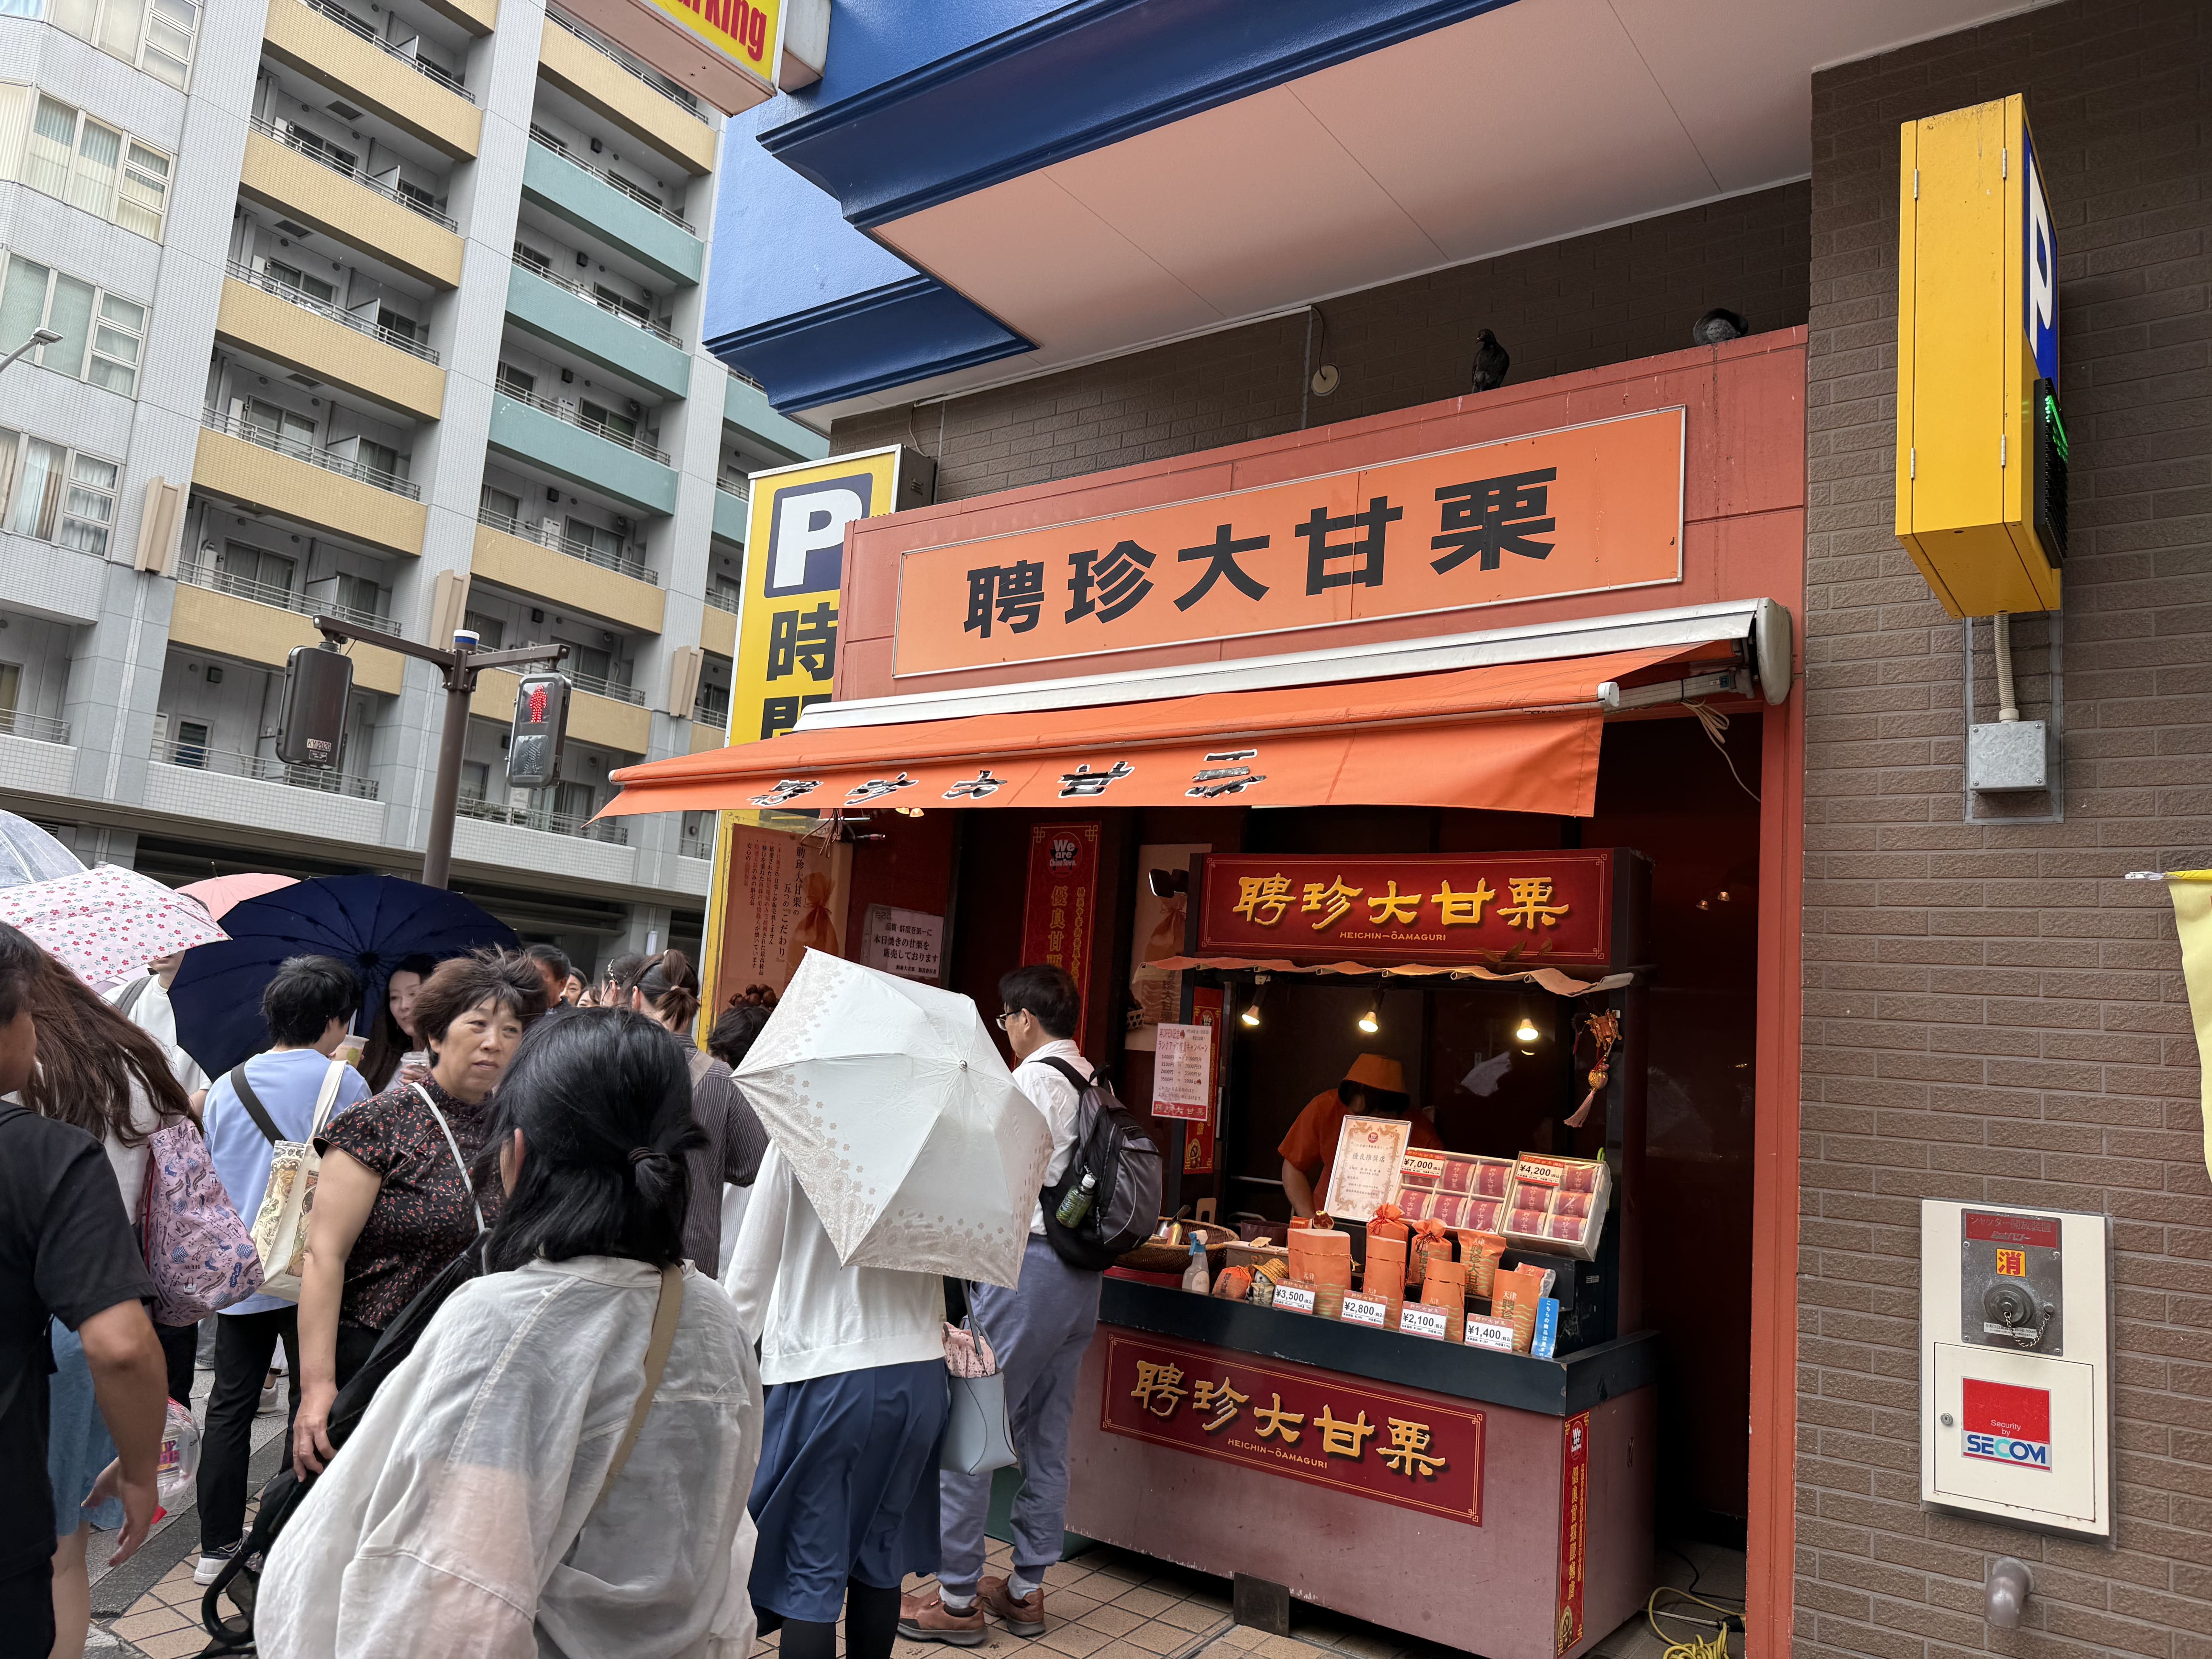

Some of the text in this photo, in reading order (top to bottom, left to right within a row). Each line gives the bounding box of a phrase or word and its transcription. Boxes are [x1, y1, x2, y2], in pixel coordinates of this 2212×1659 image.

[774, 488, 862, 589] P
[963, 467, 1557, 639] 聘珍大甘栗
[317, 741, 331, 750] 2020
[1053, 839, 1075, 852] We
[1233, 872, 1569, 929] 聘珍大甘栗
[883, 948, 939, 963] 販売しております
[1404, 1158, 1433, 1169] ¥7,000
[1519, 1164, 1551, 1176] ¥4,200
[1998, 1251, 2022, 1275] 消
[1276, 1288, 1304, 1302] ¥3,500
[1345, 1301, 1375, 1316] ¥2,800
[1403, 1312, 1434, 1327] ¥2,100
[1468, 1324, 1501, 1340] ¥1,400
[1131, 1360, 1446, 1476] 聘珍大甘栗
[1990, 1419, 2021, 1432] Security
[2001, 1428, 2010, 1437] by
[1967, 1434, 2046, 1464] SECOM
